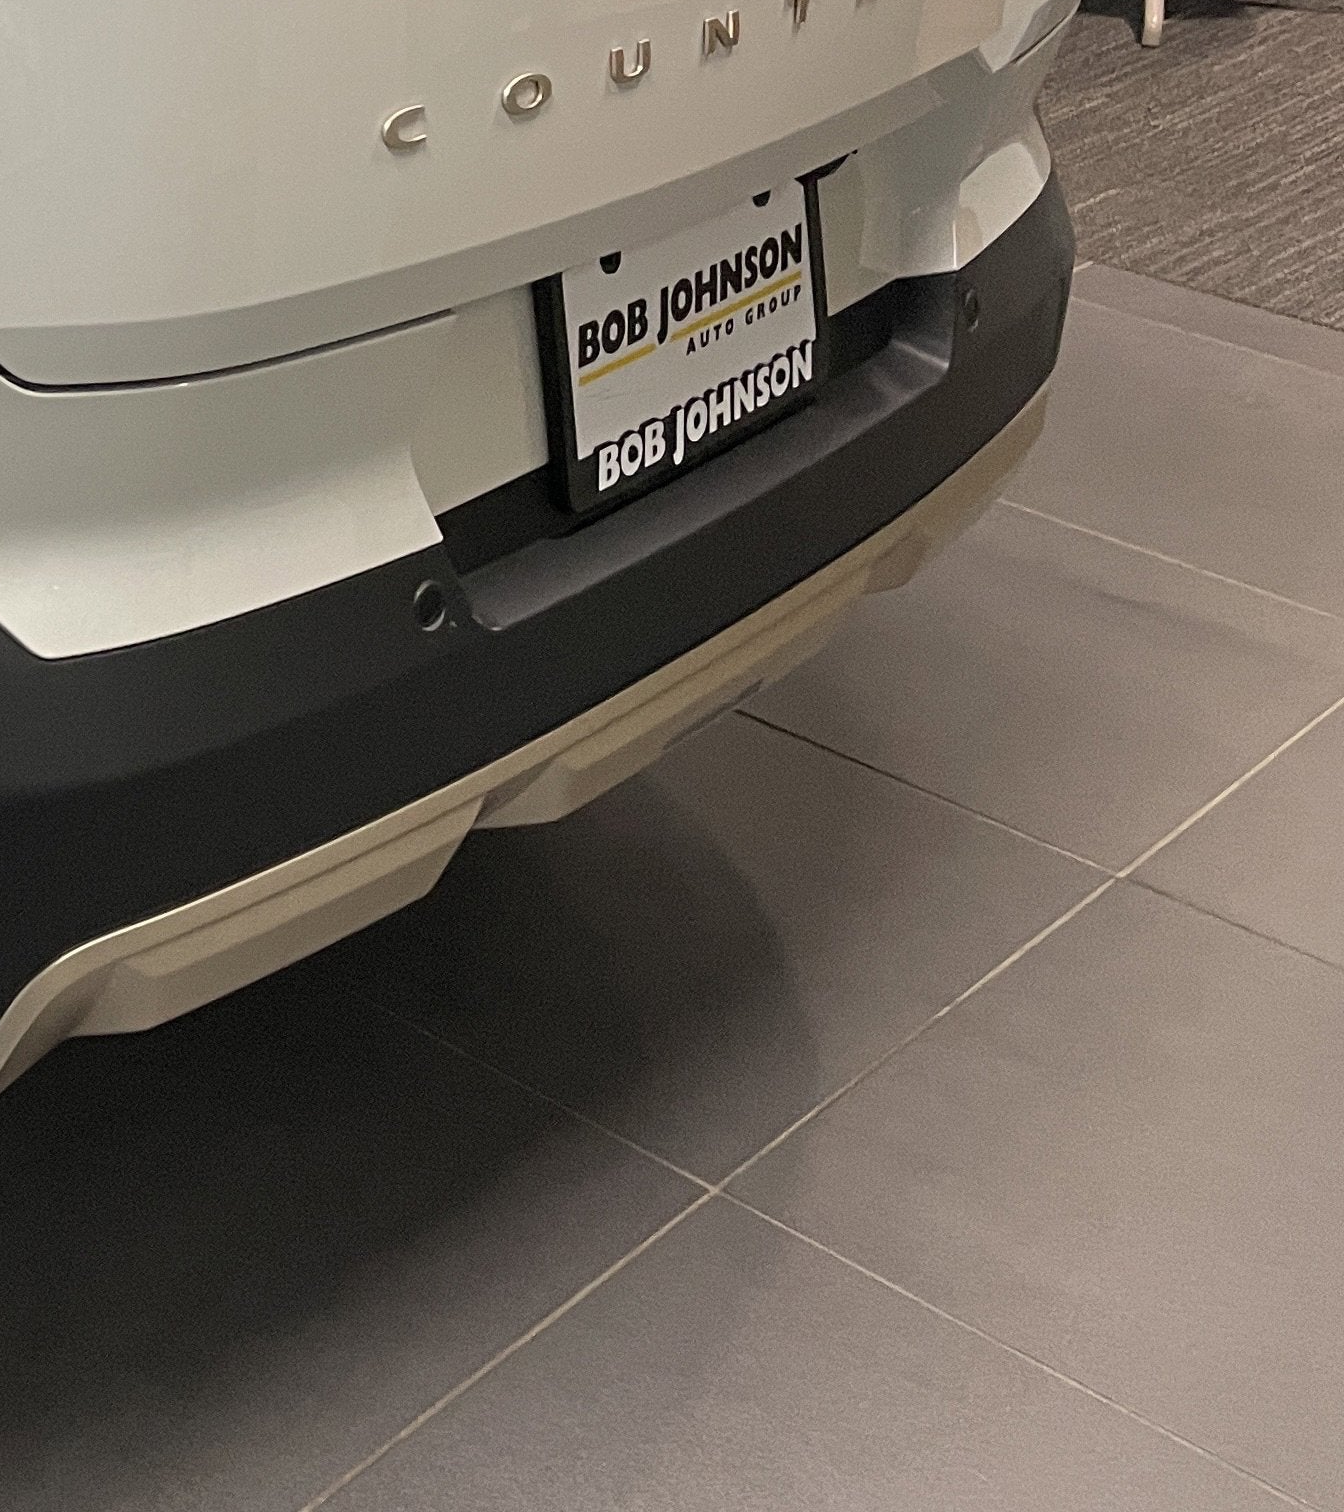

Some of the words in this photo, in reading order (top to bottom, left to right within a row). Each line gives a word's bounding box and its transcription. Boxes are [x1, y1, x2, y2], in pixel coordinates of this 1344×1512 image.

[577, 298, 649, 369] BOB
[656, 222, 803, 346] JOHNSON
[685, 318, 735, 356] AUTO
[744, 284, 802, 326] GROUP
[598, 419, 667, 492] BOB
[672, 341, 813, 466] JOHNSON
